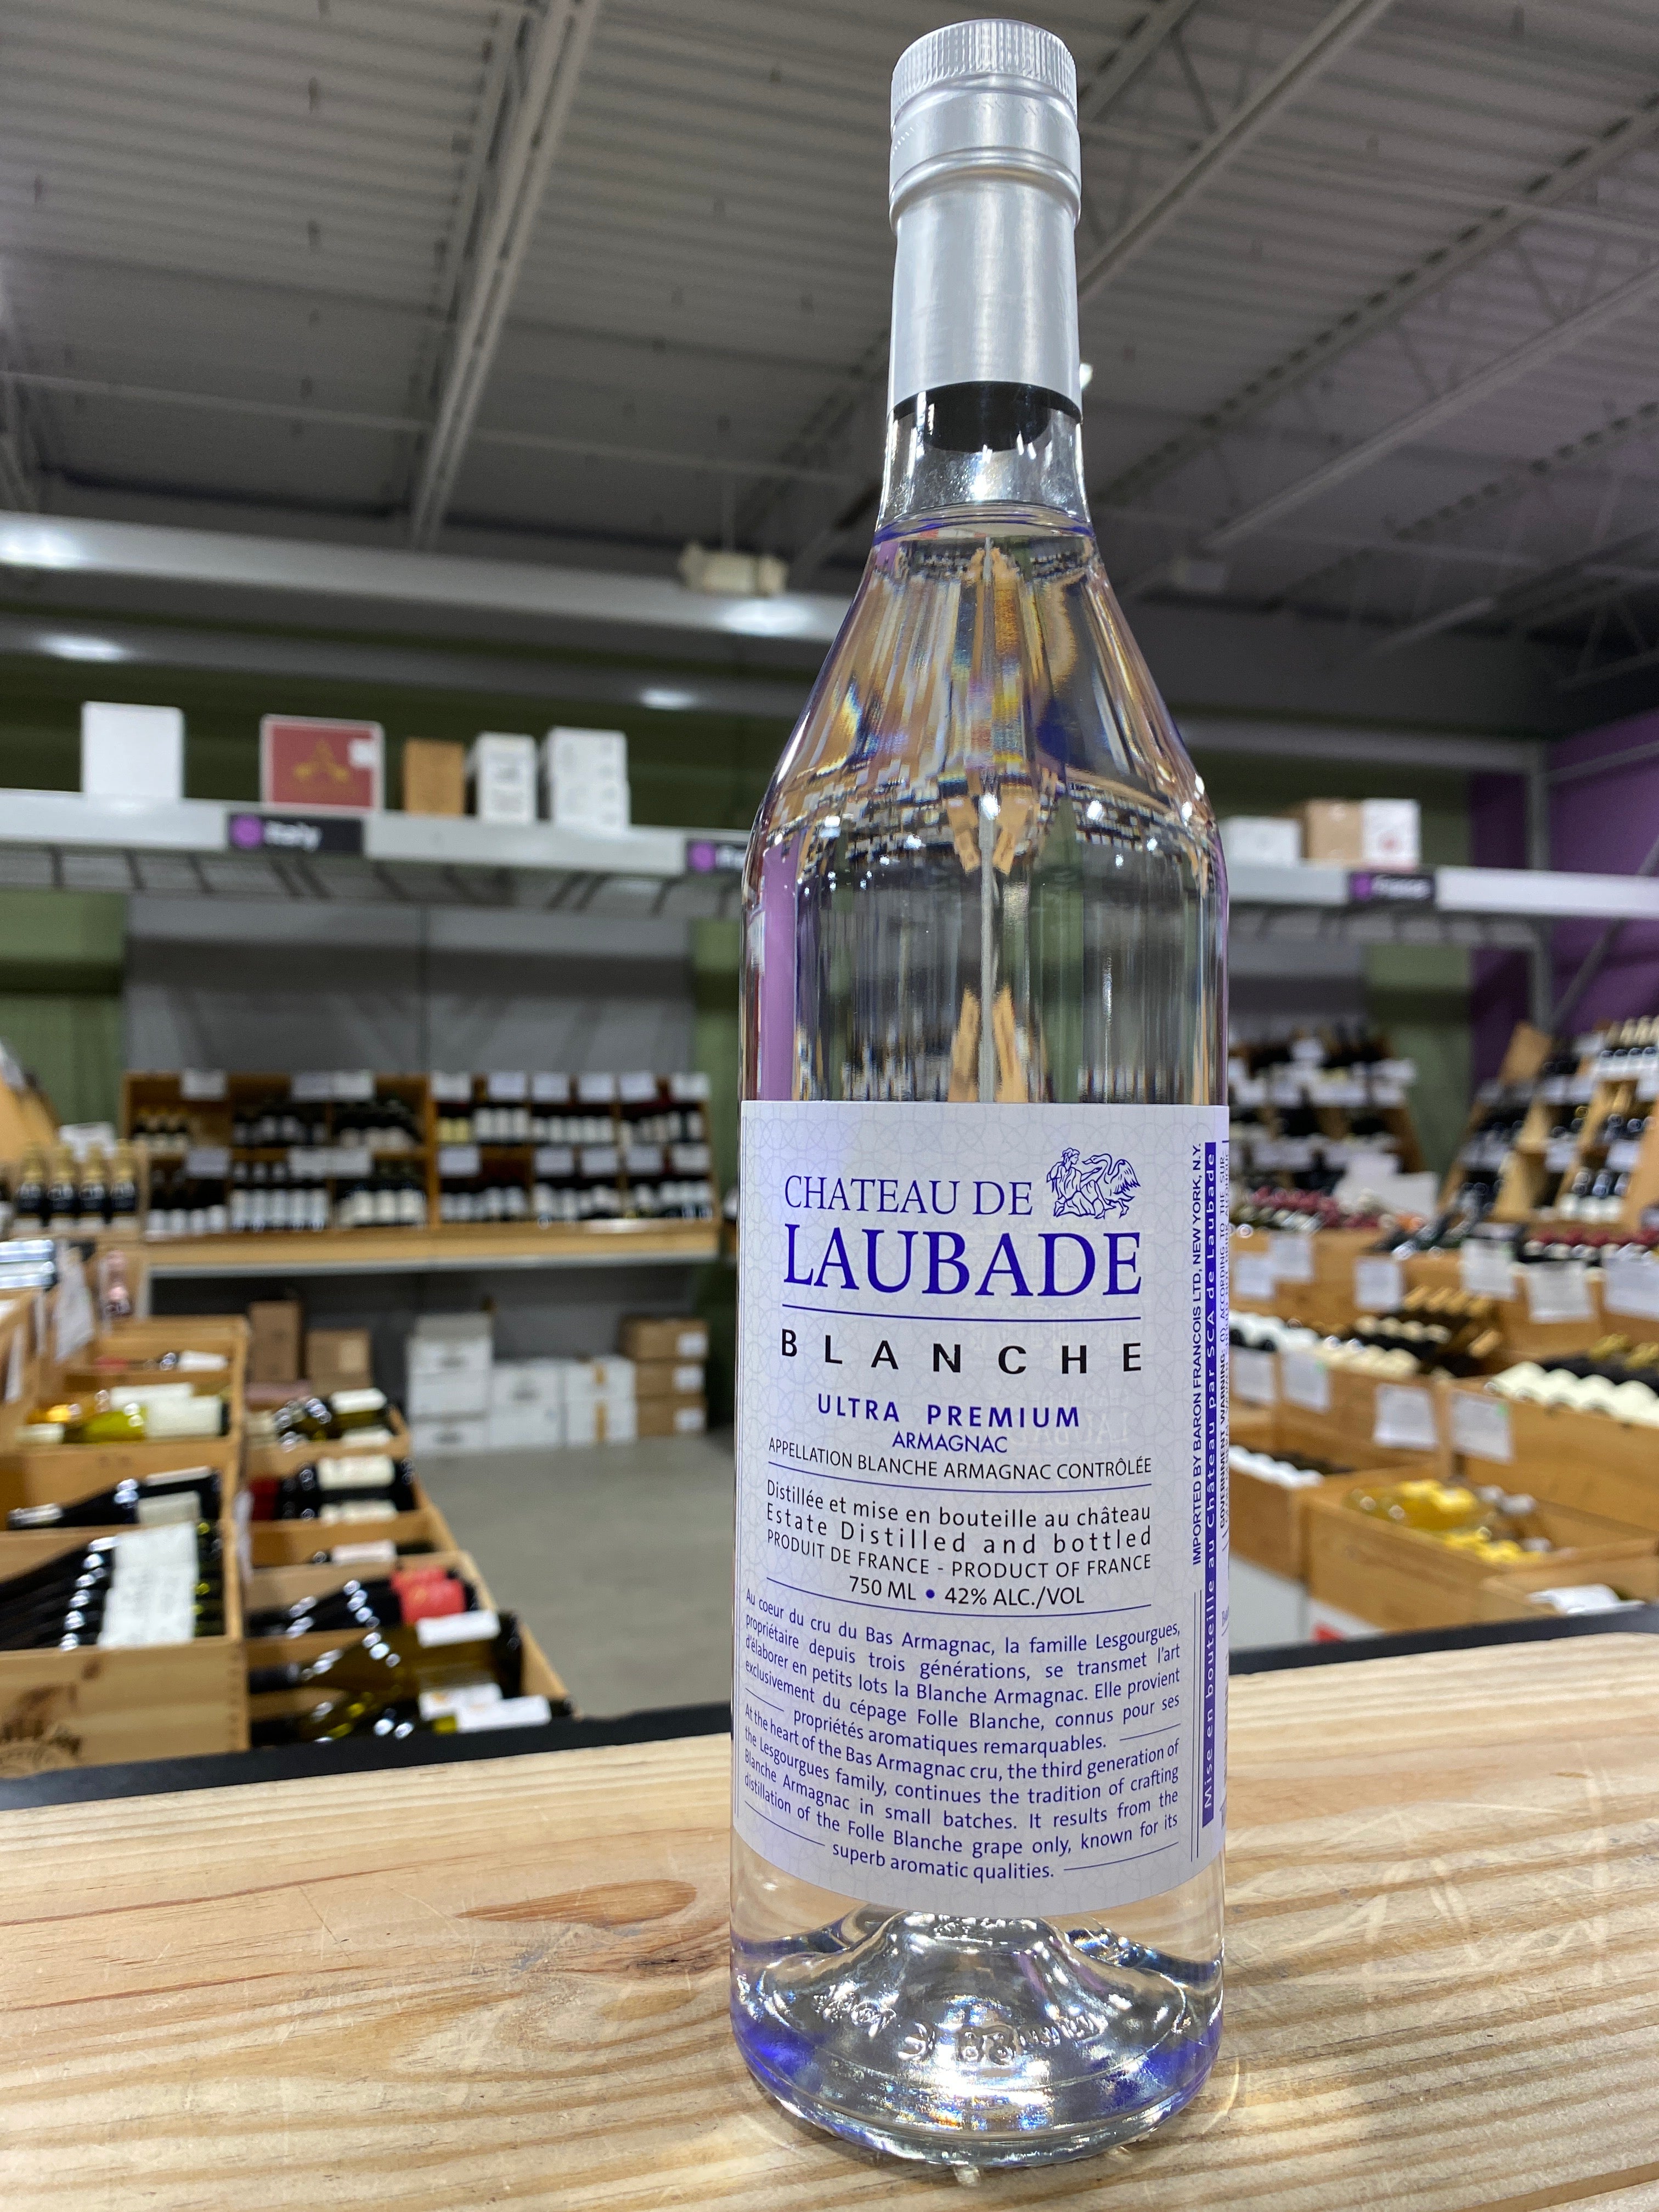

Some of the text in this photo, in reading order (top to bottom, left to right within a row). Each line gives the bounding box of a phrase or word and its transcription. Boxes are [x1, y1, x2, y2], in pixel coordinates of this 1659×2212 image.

[785, 1175, 1032, 1215] CHATEAU DE
[1220, 1223, 1224, 1239] TO
[783, 1223, 1141, 1296] LAUBADE
[1207, 1271, 1215, 1299] de
[782, 1328, 1141, 1374] BLANCHE
[1192, 1143, 1203, 1565] IMPORTED BY BARON FRANCOIS LTD, NEW YORK, N.Y.
[1207, 1310, 1215, 1358] SCA
[819, 1393, 900, 1423] ULTRA
[928, 1404, 1079, 1428] PREMIUM
[769, 1437, 1151, 1480] APPELLATION BLANCHE ARMAGNAC CONTRÔLÉE
[891, 1430, 1007, 1453] ARMAGNAC
[1206, 1421, 1215, 1530] Château
[768, 1479, 1150, 1527] Distillée et mise en bouteille au château
[768, 1502, 1150, 1554] Estate Distilled and bottled
[768, 1529, 825, 1559] PRODUIT
[831, 1547, 850, 1564] DE
[859, 1551, 929, 1575] FRANCE
[952, 1561, 1048, 1578] PRODUCT
[1056, 1561, 1080, 1578] OF
[1088, 1554, 1150, 1576] FRANCE
[1209, 1539, 1215, 1570] au
[850, 1576, 1085, 1609] 750 ML 42% ALC./VOL
[746, 1588, 1180, 1657] Au coeur du cru du Bas Armagnac, la famille Lesgourgues,
[1205, 1578, 1214, 1699] bouteille
[746, 1614, 799, 1649] propriétaire
[809, 1638, 855, 1663] depuis
[868, 1652, 905, 1671] trois
[920, 1659, 1030, 1681] générations,
[1046, 1666, 1063, 1678] se
[1077, 1652, 1147, 1675] transmet
[746, 1660, 1179, 1731] exclusivement du cépage Folle Blanche, connus pour ses
[793, 1661, 806, 1677] en
[813, 1667, 852, 1688] petits
[860, 1674, 887, 1694] lots
[895, 1679, 909, 1697] la
[917, 1684, 986, 1703] Blanche
[994, 1689, 1087, 1708] Armagnac.
[1096, 1681, 1121, 1699] Elle
[1128, 1668, 1180, 1699] provient
[746, 1703, 1180, 1782] At the heart of the Bas Armagnac cru, the third generation of
[794, 1709, 1106, 1758] propriétés aromatiques remarquables.
[1206, 1707, 1213, 1738] en
[745, 1726, 1178, 1804] the Lesgourgues family, continues the tradition of crafting
[746, 1748, 1178, 1829] Blanche Armagnac in small batches. It results from the
[1204, 1747, 1213, 1809] Mise
[745, 1772, 1177, 1859] distillation of the Folle Blanche grape only, known for its
[833, 1844, 1053, 1884] superb aromatic qualities.
